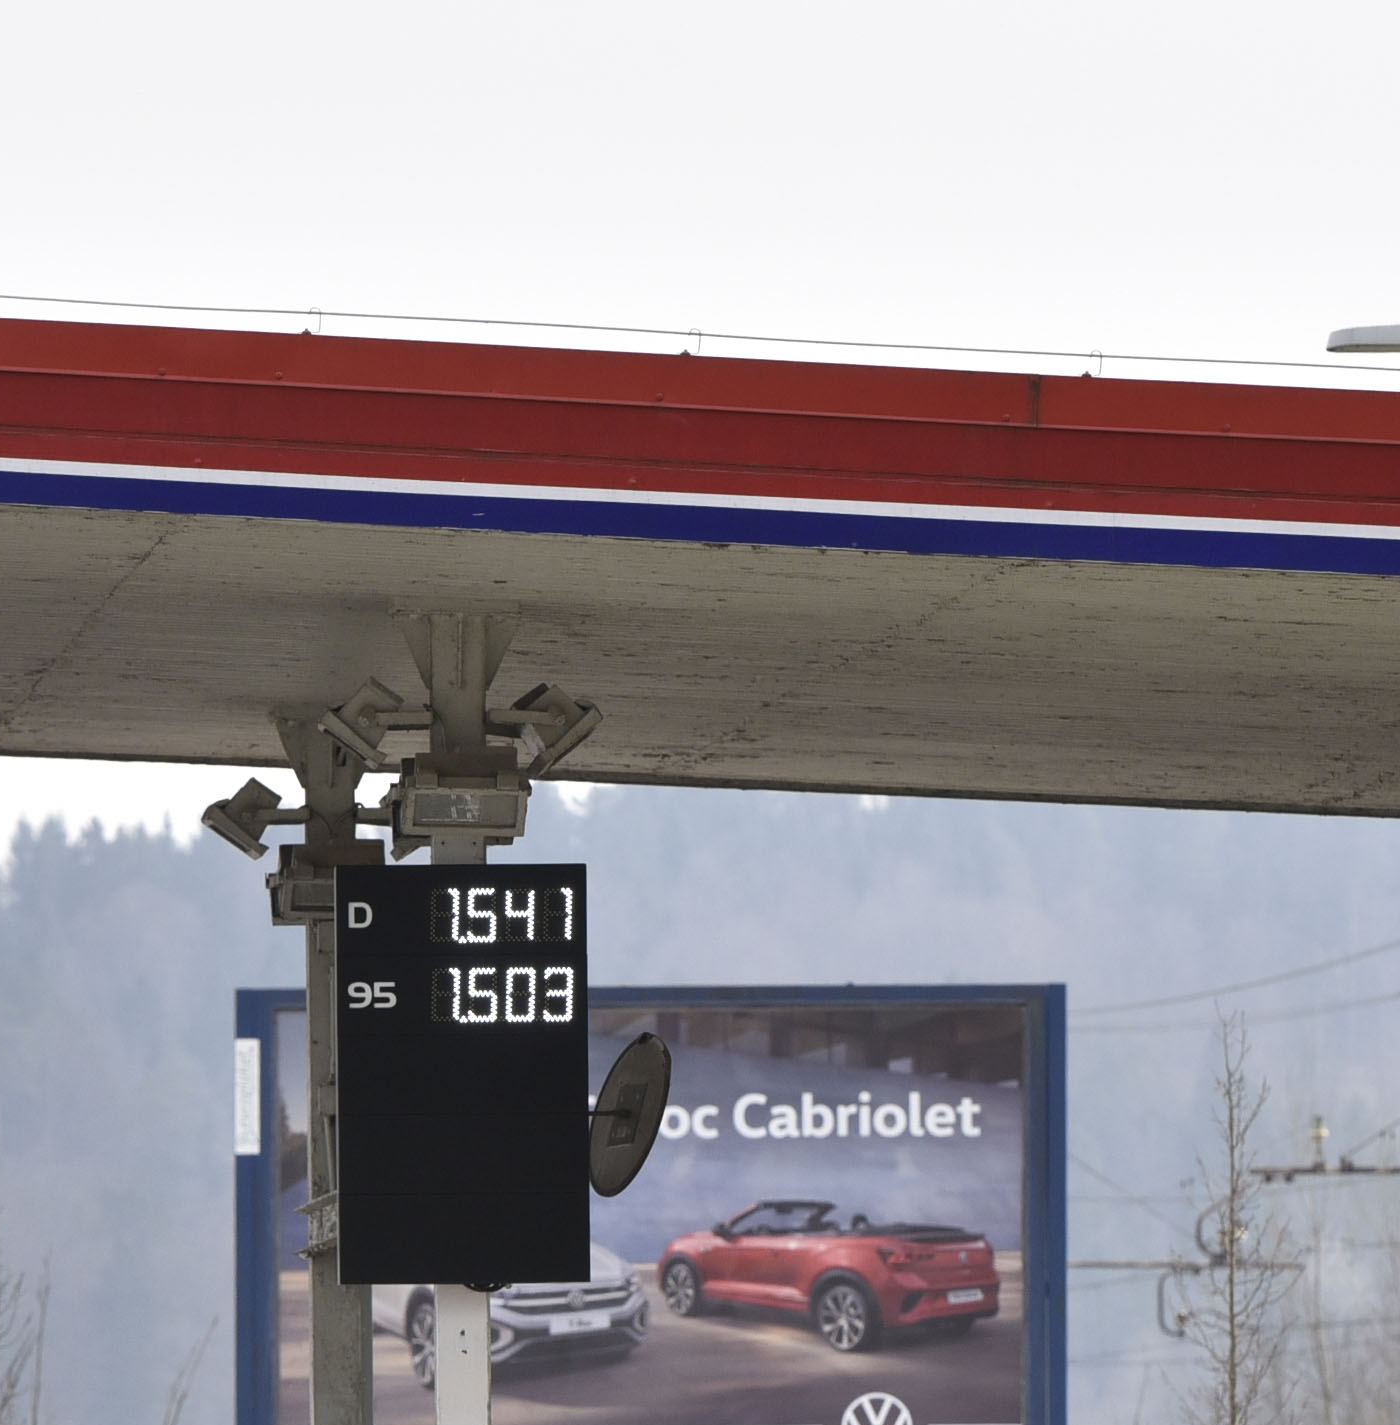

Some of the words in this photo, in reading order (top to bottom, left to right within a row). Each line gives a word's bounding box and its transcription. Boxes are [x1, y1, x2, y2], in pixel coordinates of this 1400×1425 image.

[347, 902, 373, 929] D
[347, 981, 398, 1009] 95
[732, 1090, 982, 1140] Cabriolet
